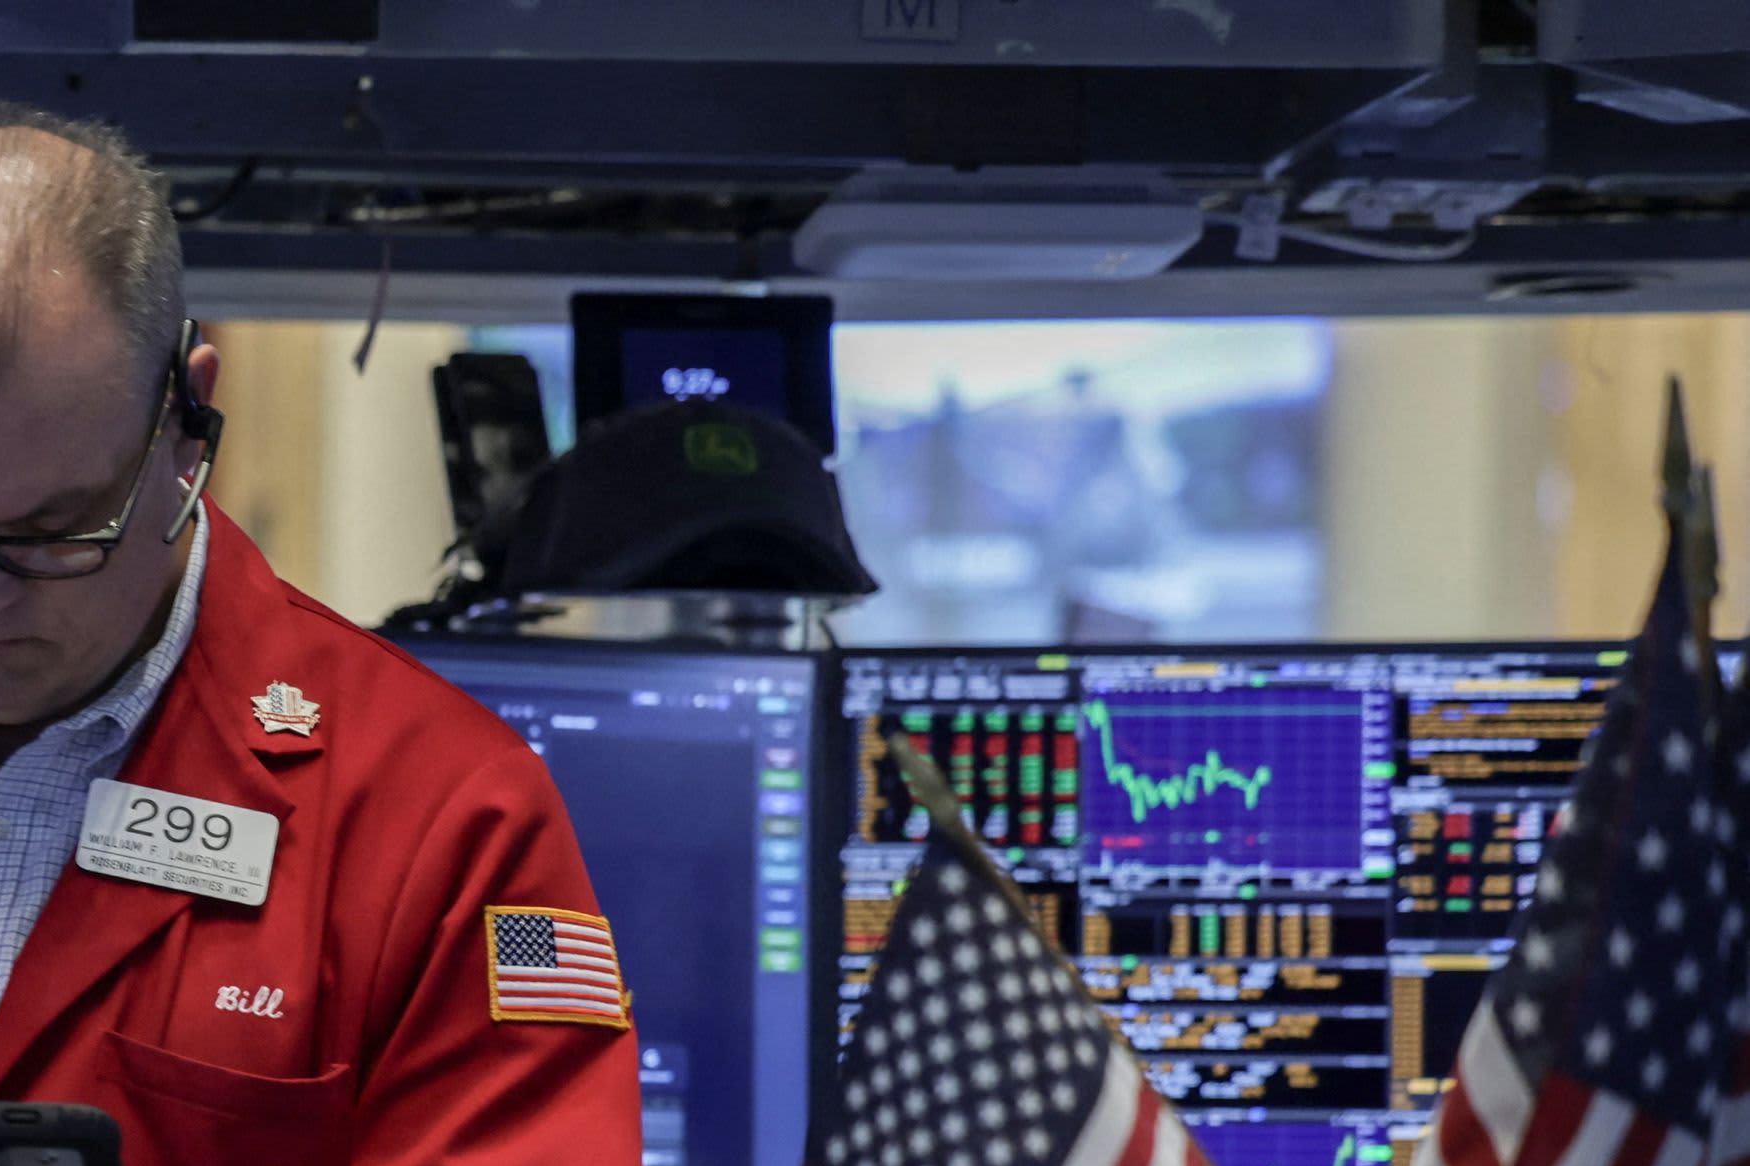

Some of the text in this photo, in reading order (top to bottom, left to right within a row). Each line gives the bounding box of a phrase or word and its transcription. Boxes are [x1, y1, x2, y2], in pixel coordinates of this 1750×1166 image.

[89, 832, 143, 852] WILLIAM
[126, 798, 233, 851] 299
[89, 855, 158, 877] ROSENBLATT
[162, 871, 224, 894] SECURITIES
[215, 985, 284, 1019] Bill
